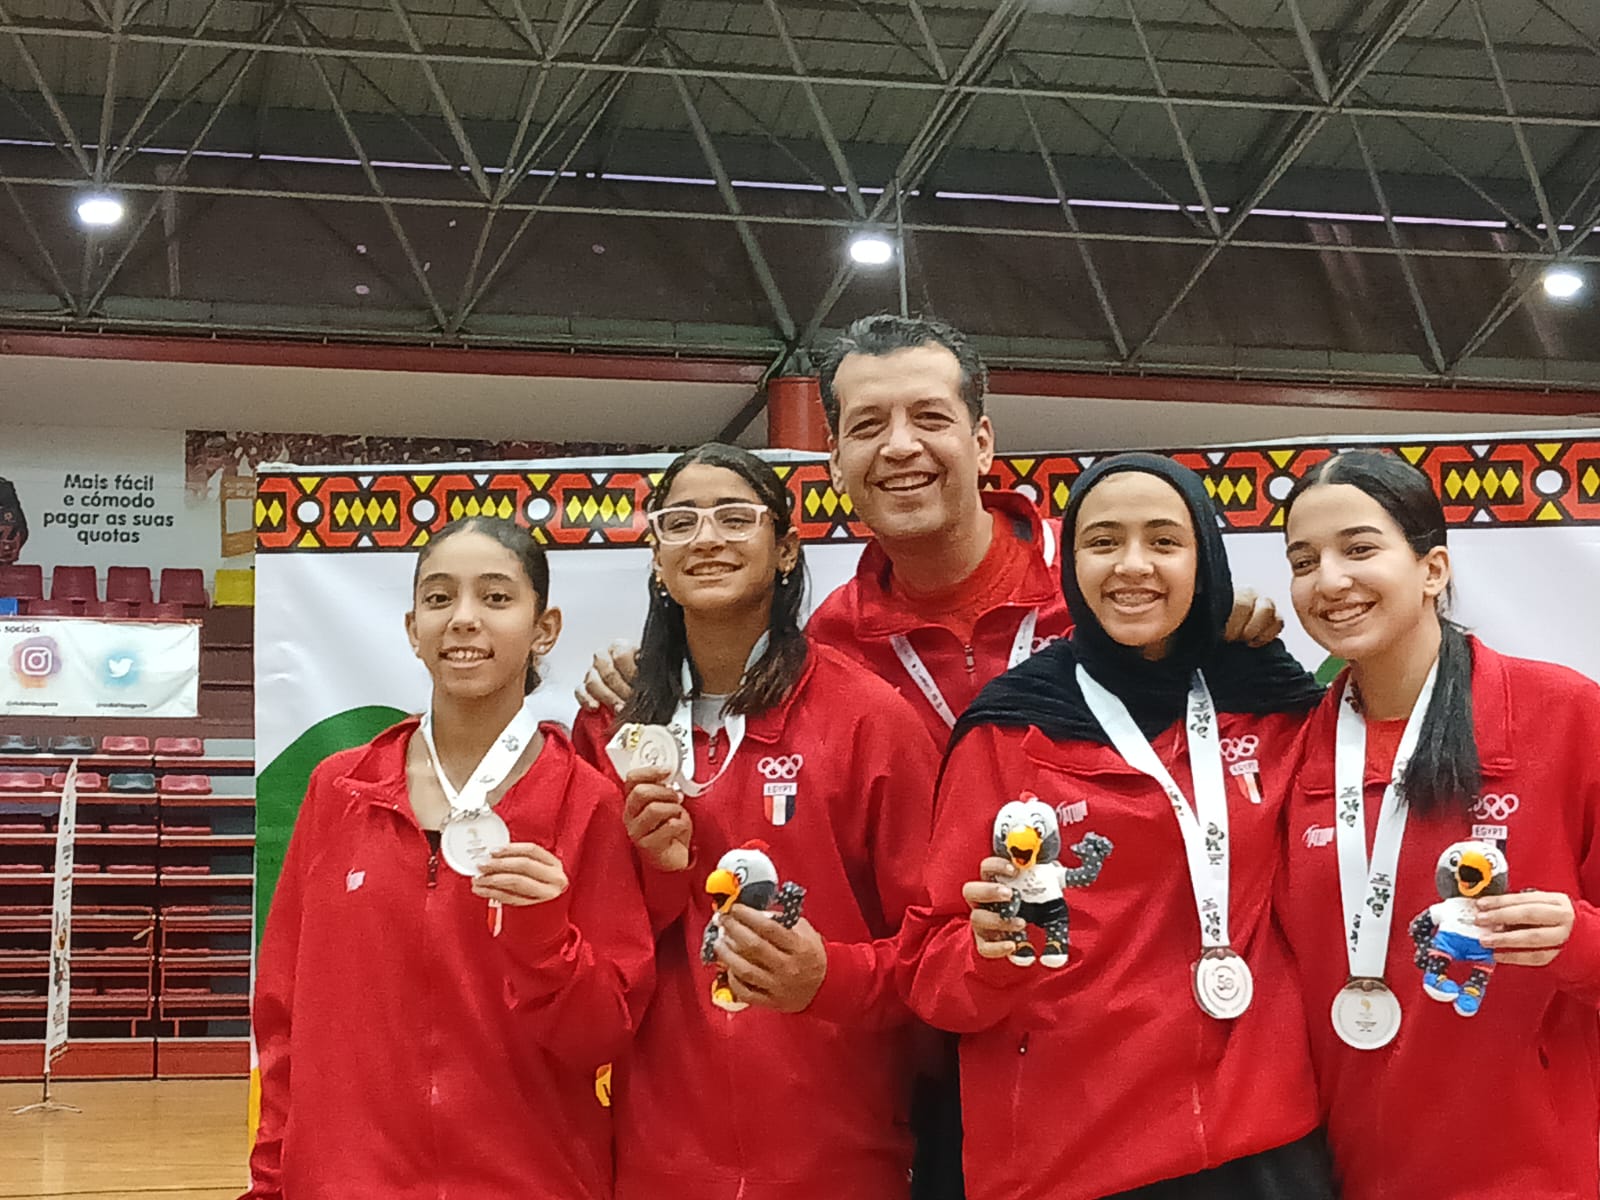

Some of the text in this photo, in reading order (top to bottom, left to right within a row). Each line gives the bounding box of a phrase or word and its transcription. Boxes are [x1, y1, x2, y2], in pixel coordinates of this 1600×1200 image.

[64, 474, 153, 491] Mais fácil
[63, 491, 155, 508] e cómodo
[43, 512, 174, 528] pagar as suas
[77, 528, 140, 545] quotas
[1475, 826, 1503, 836] EGYPT
